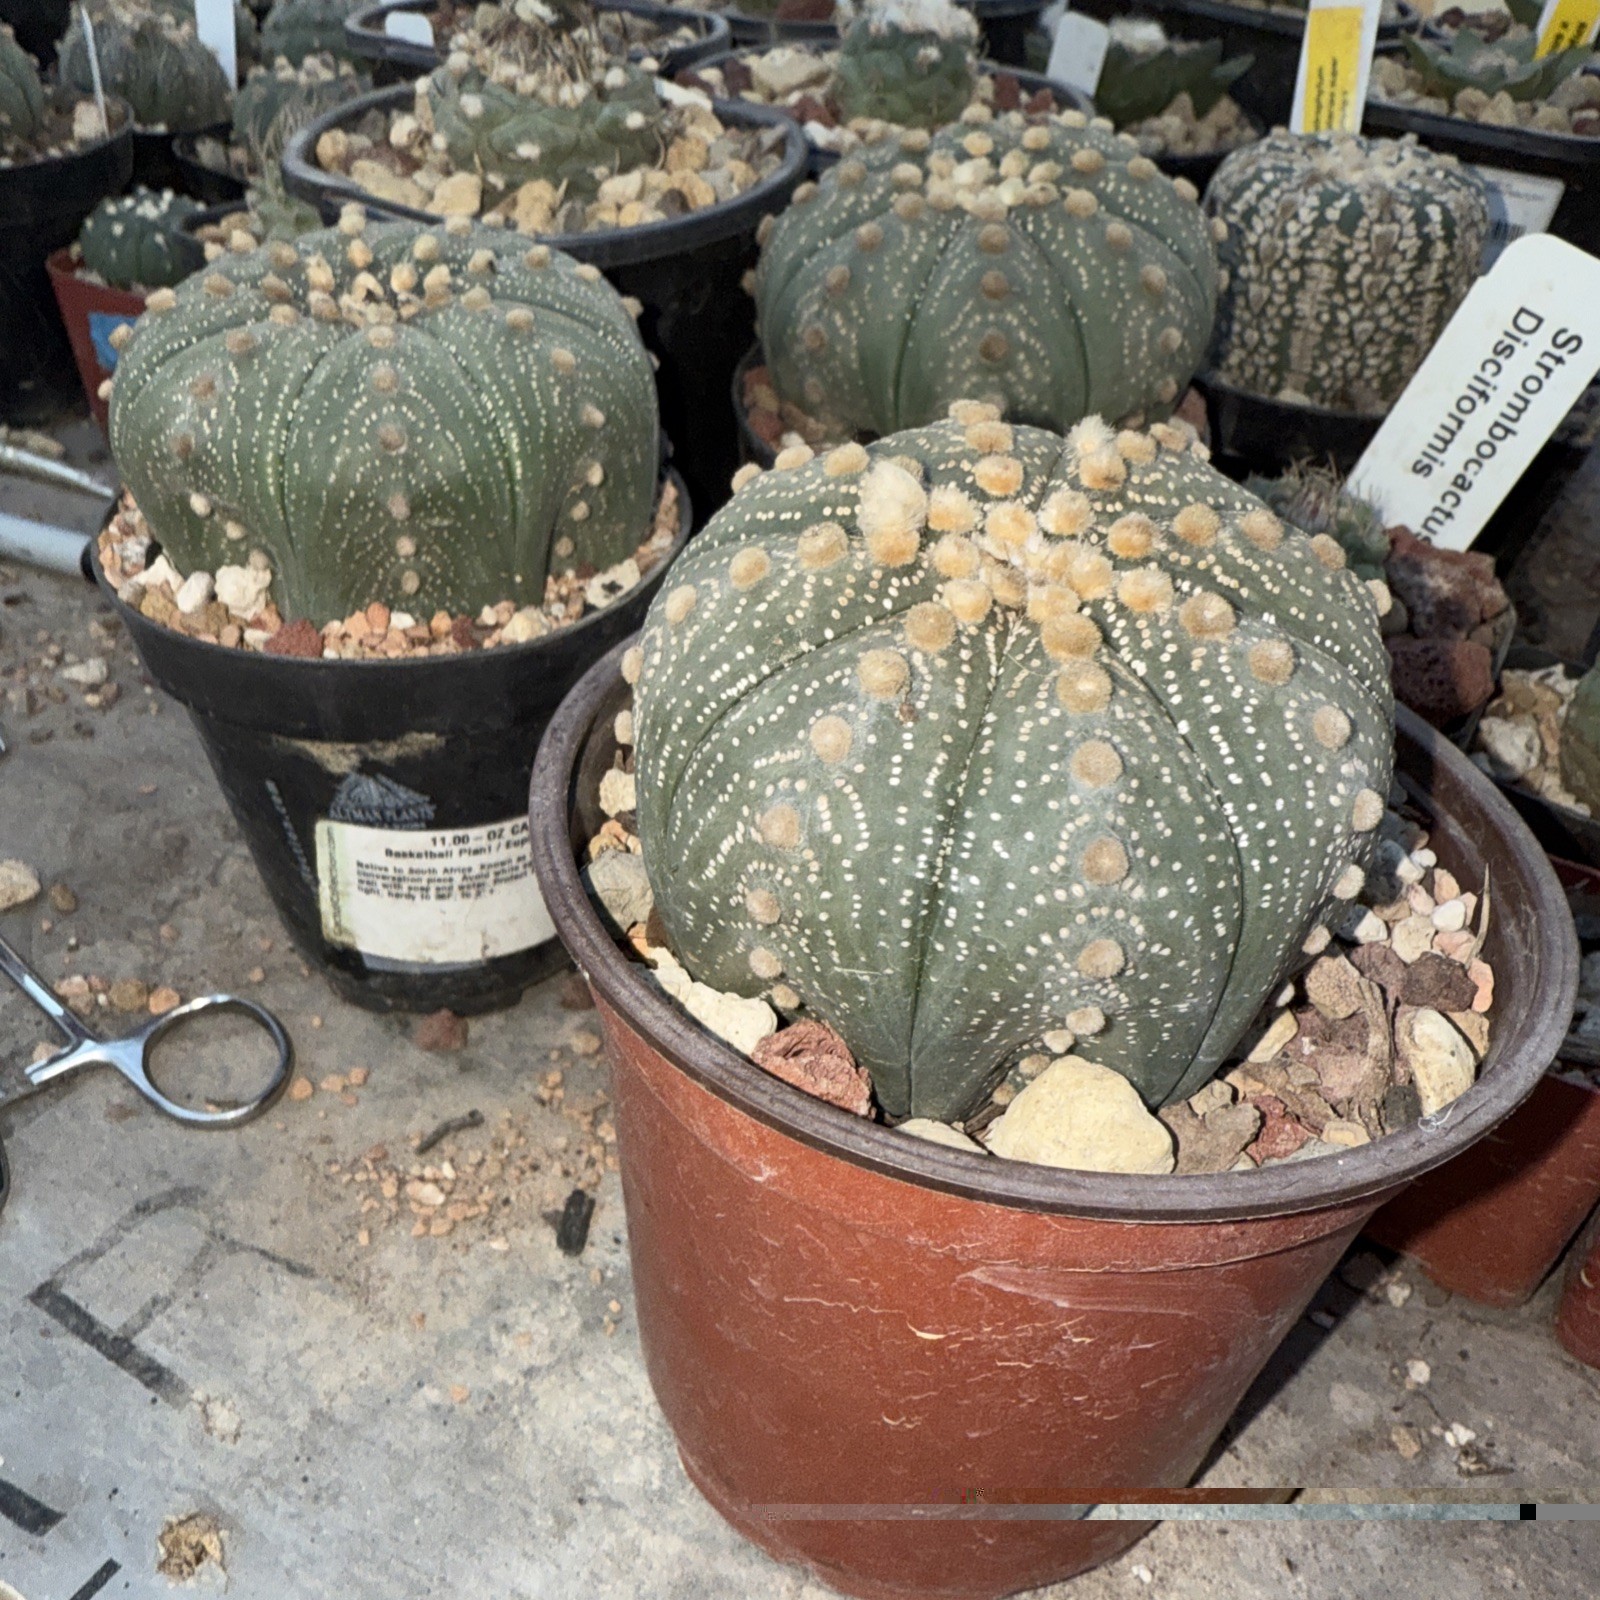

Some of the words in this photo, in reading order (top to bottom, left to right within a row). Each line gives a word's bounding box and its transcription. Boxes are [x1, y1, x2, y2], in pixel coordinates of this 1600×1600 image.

[1411, 306, 1545, 479] Disciformis
[431, 834, 470, 847] 11.00
[487, 827, 505, 841] OZ
[385, 847, 453, 859] Basketball
[458, 845, 492, 857] Plant
[356, 860, 389, 872] Native
[393, 866, 404, 874] to
[408, 867, 438, 875] South
[480, 858, 513, 870] Known
[462, 872, 490, 882] Avoid
[382, 882, 403, 891] with
[435, 884, 454, 892] and
[388, 890, 416, 901] hardy
